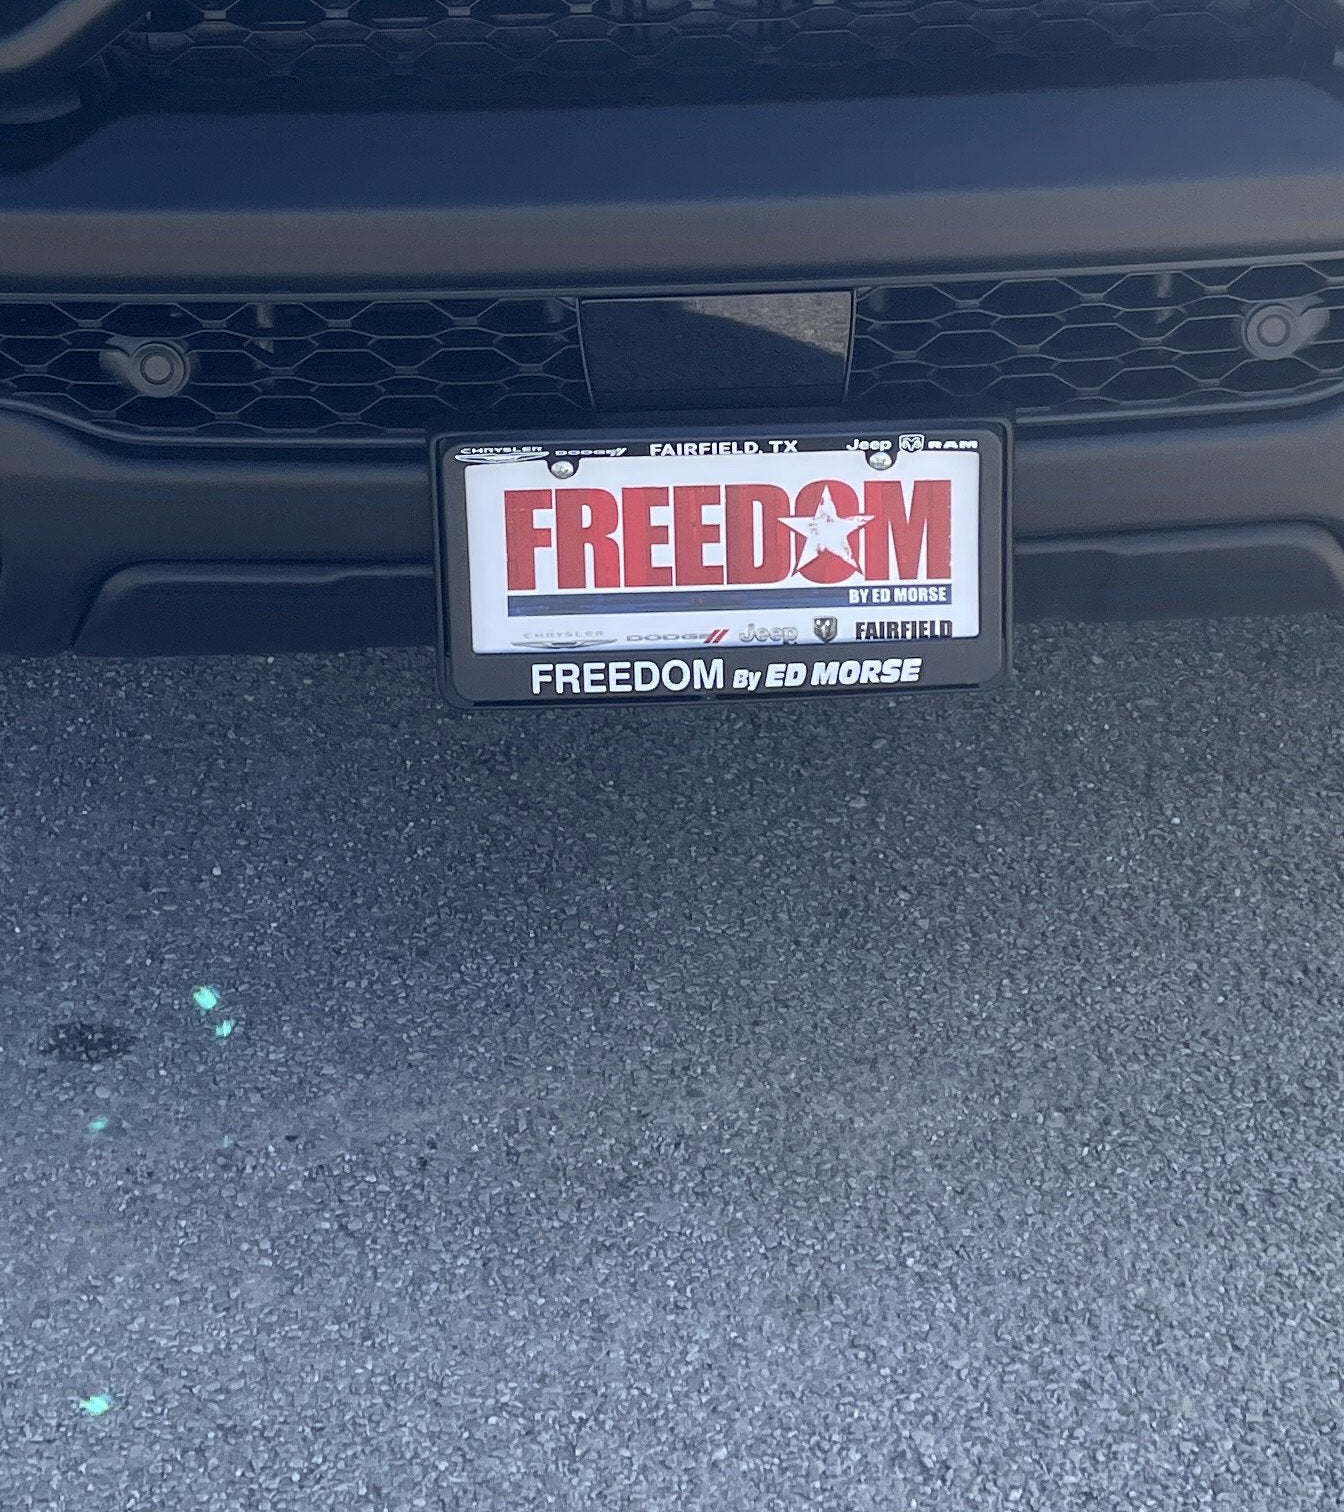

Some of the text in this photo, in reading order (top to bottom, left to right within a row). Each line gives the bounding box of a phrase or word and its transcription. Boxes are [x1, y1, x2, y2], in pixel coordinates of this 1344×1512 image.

[460, 445, 543, 455] CHRYSLER
[649, 439, 799, 457] FAIRFIELD, TX
[846, 438, 893, 451] Jeep
[927, 440, 979, 450] RAM
[503, 479, 953, 592] FREEDOM
[848, 586, 948, 605] BY ED MORSE
[523, 630, 605, 639] CHRYSLER
[626, 632, 713, 642] DODGE
[739, 623, 799, 646] Jeep
[855, 619, 954, 641] FAIRFIELD
[530, 657, 923, 695] FREEDOM By ED MORSE
